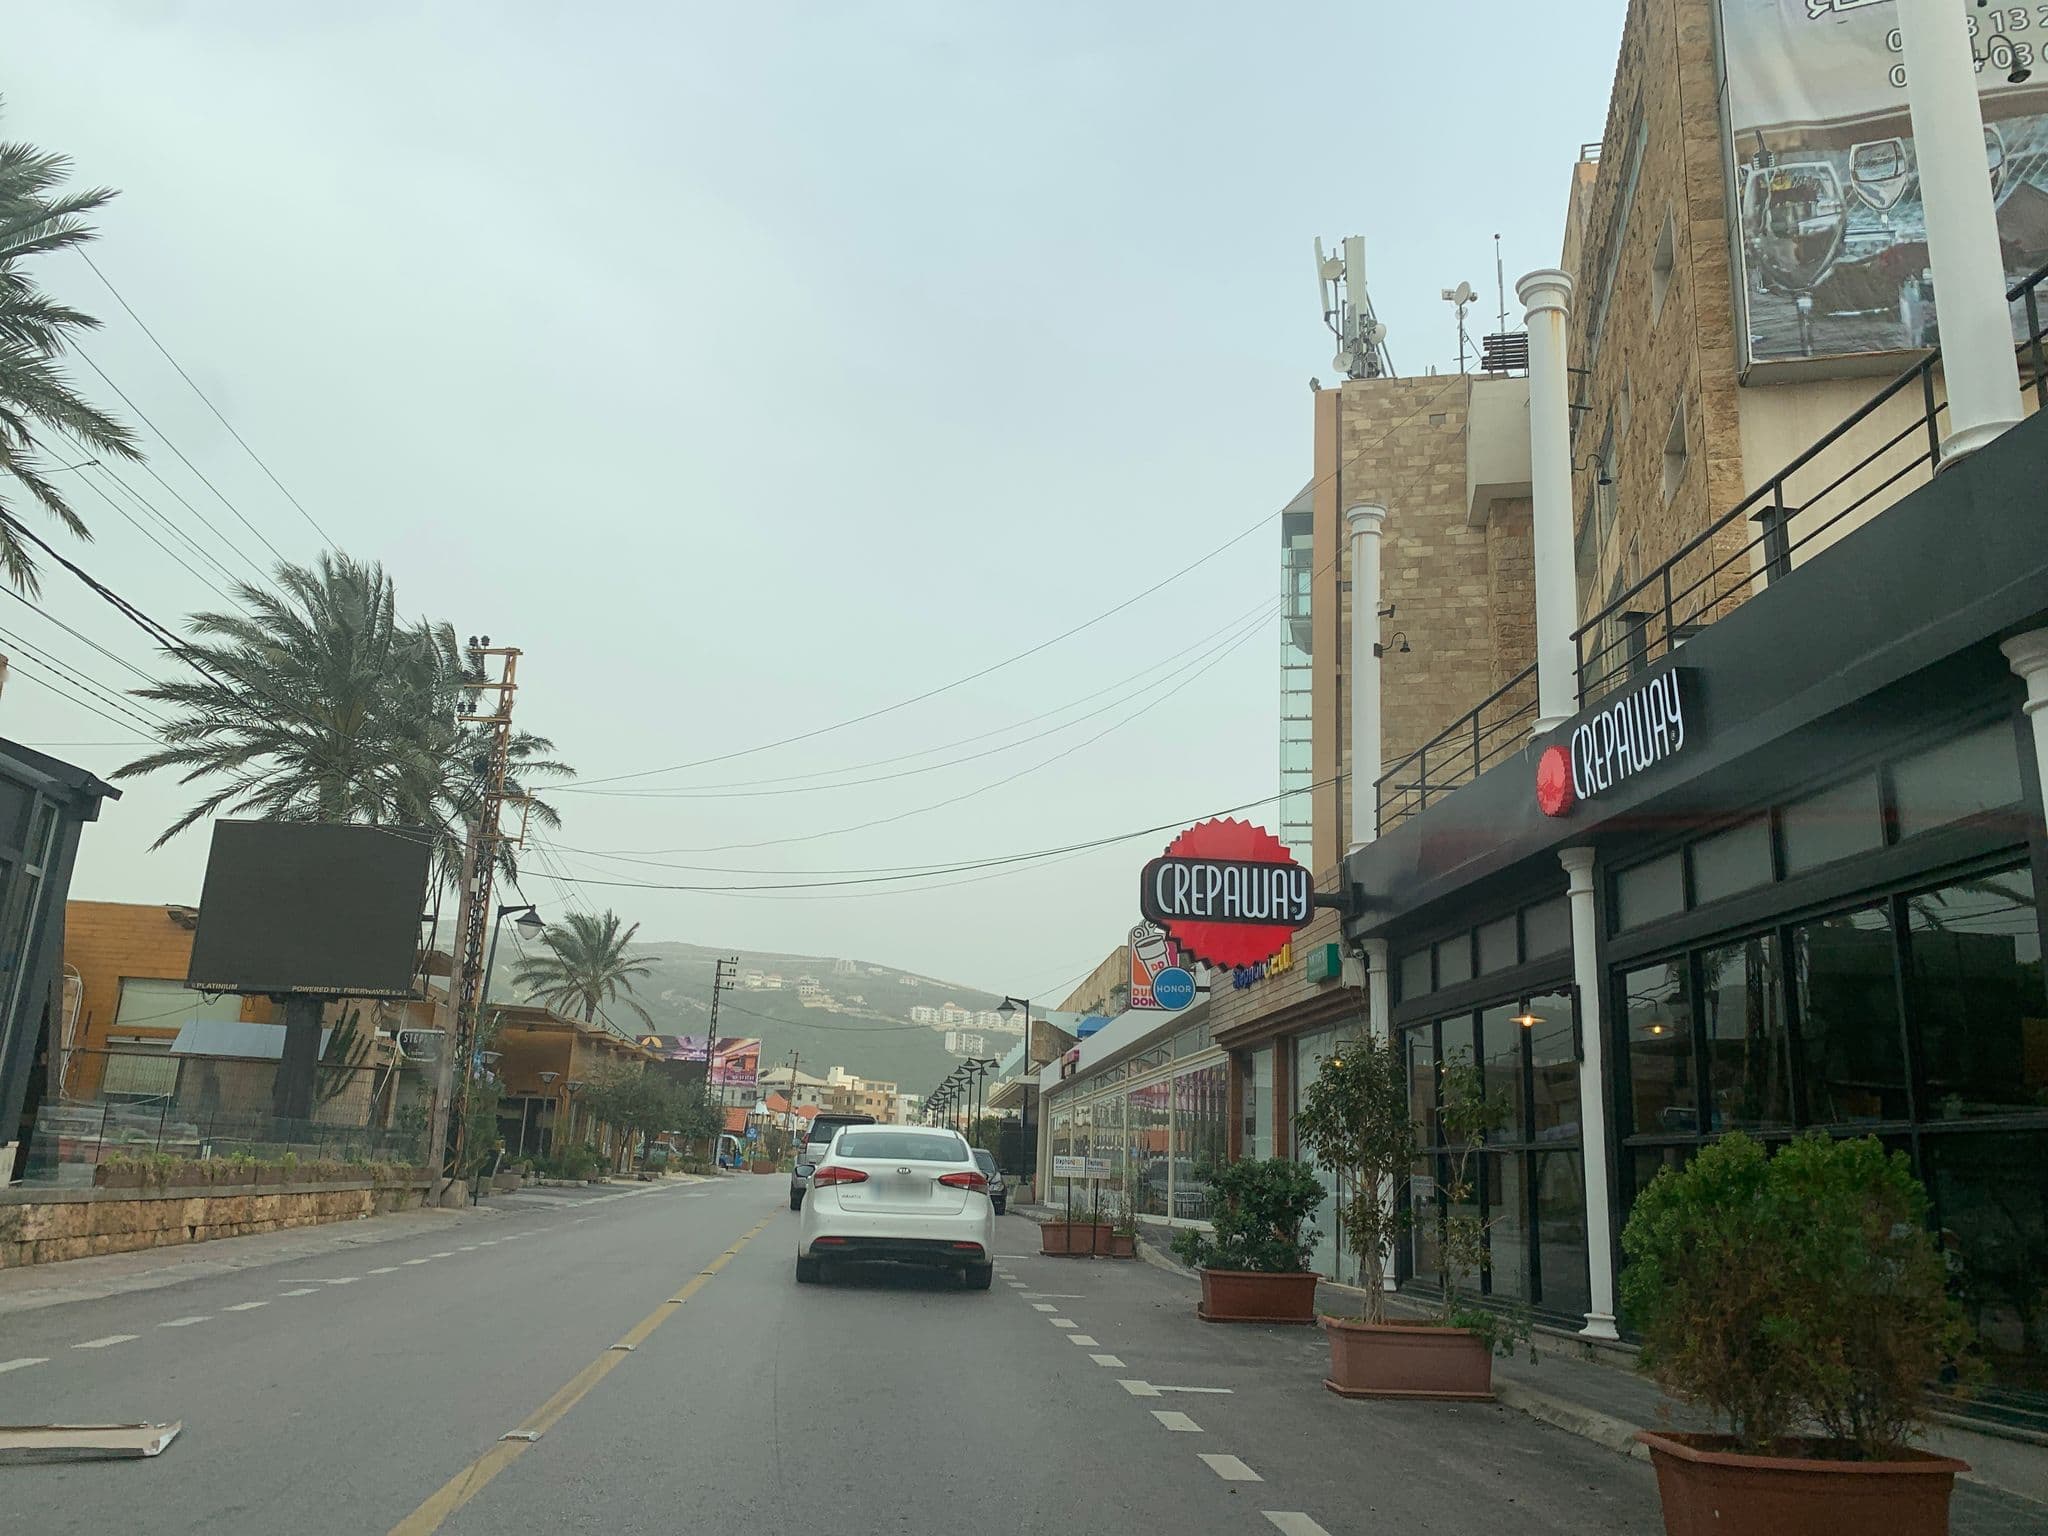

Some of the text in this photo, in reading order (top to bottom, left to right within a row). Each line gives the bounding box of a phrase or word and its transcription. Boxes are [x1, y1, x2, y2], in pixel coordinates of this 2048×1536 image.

[1989, 7, 2030, 33] 13
[1570, 667, 1685, 801] CREPAWAY
[1156, 862, 1308, 921] CREPAWAY
[196, 982, 238, 990] PLATINIUM
[291, 985, 330, 993] POWERED
[330, 986, 341, 994] BY
[1156, 985, 1193, 993] HONOR
[1132, 997, 1156, 1007] DON
